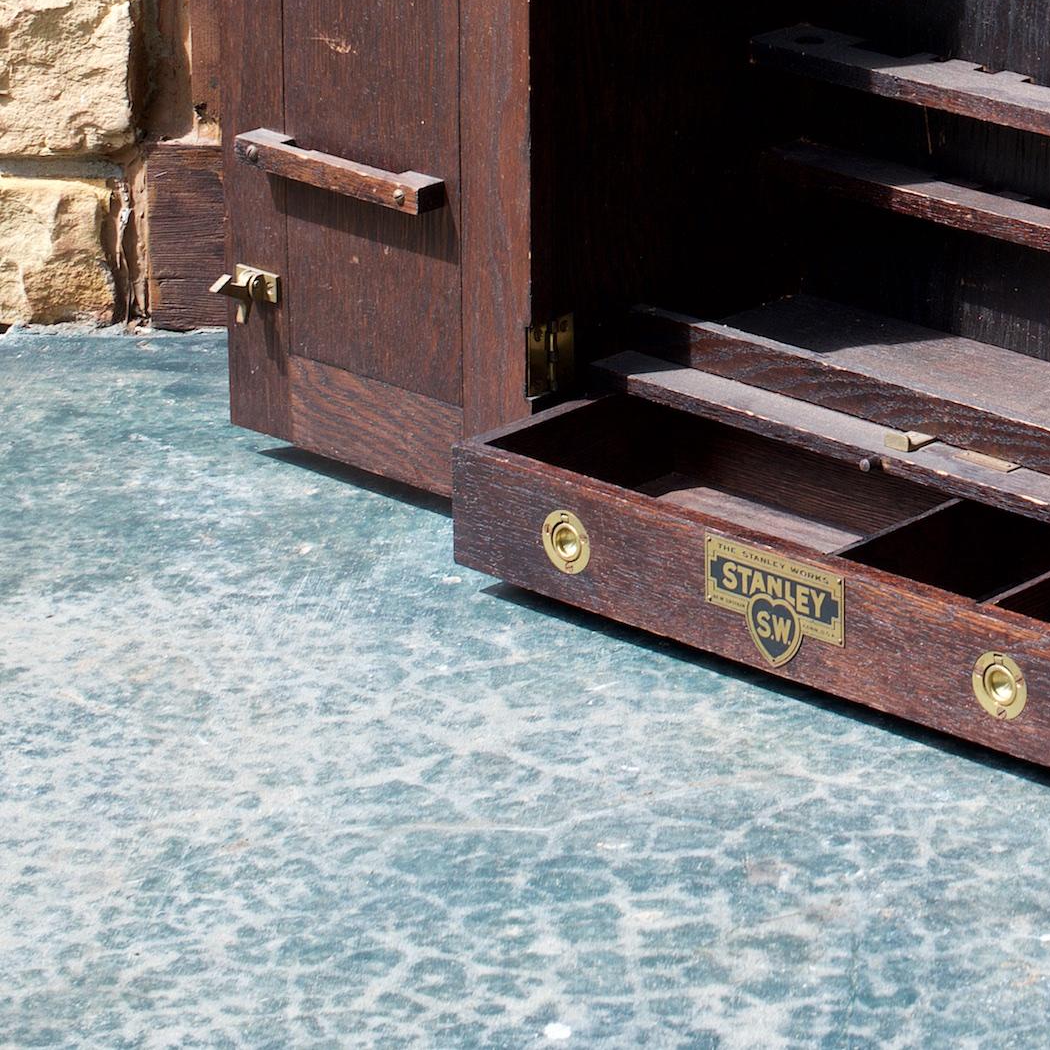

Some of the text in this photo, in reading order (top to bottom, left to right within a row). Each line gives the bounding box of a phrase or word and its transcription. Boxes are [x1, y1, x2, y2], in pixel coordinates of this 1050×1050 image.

[718, 543, 829, 584] THE STANLEY WORKS
[722, 562, 826, 618] STANLEY
